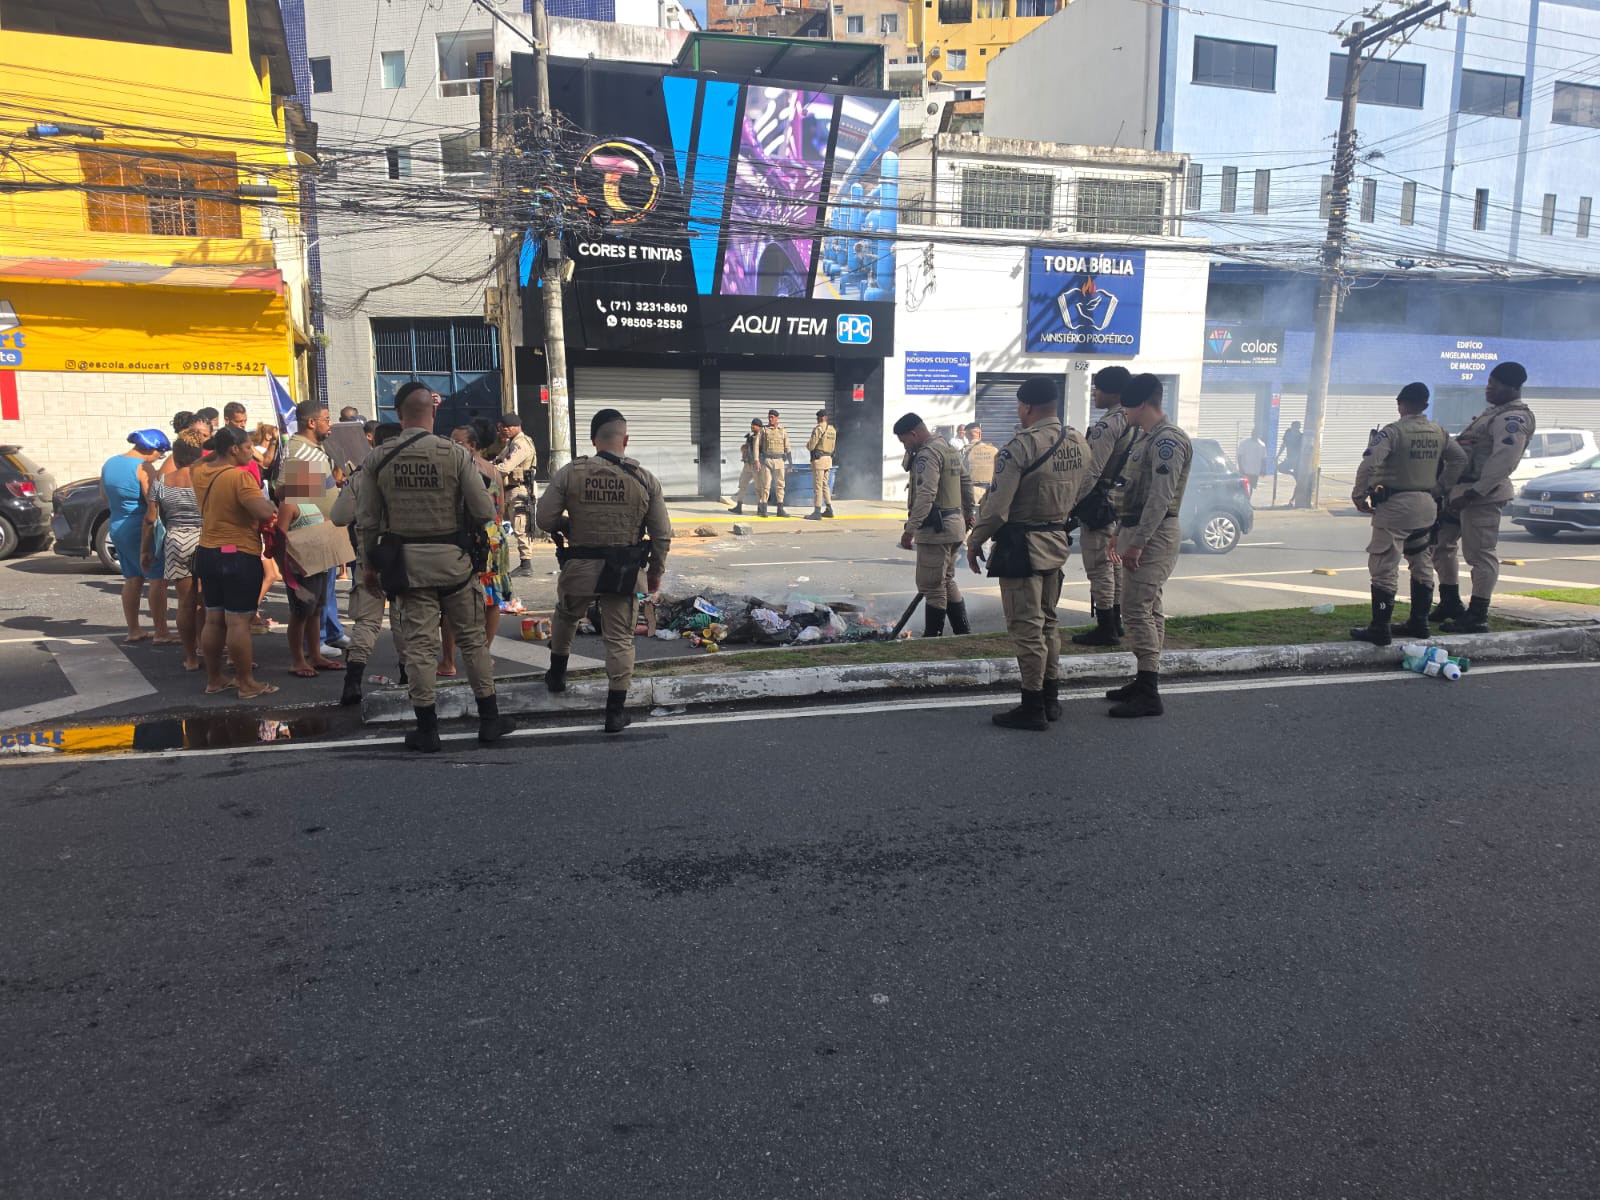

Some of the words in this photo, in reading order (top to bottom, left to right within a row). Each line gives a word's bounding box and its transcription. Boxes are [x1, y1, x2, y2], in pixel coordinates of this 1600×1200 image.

[578, 243, 626, 258] CORES
[629, 246, 637, 258] E
[640, 246, 683, 261] TINTAS
[1044, 255, 1088, 273] TODA
[1090, 254, 1134, 275] BÍBLIA
[610, 301, 631, 312] (71)
[636, 302, 688, 313] 3231-8610
[620, 317, 683, 329] 98505-2558
[730, 315, 781, 334] AQUI
[787, 317, 828, 336] TEM
[839, 317, 870, 341] PPG
[1040, 331, 1086, 343] MINISTÉRIO
[1087, 332, 1134, 344] PROFÉTICO
[1241, 339, 1278, 353] colors
[1456, 341, 1483, 349] EDIFÍCIO
[1440, 351, 1470, 359] ANGELINA
[1471, 352, 1498, 361] MOREIRA
[77, 360, 170, 371] @escola.educart
[1450, 362, 1458, 370] DE
[1459, 362, 1486, 371] MACEDO
[1052, 459, 1082, 472] MILITAR
[395, 476, 438, 488] MILITAR
[585, 490, 625, 502] MILITAR
